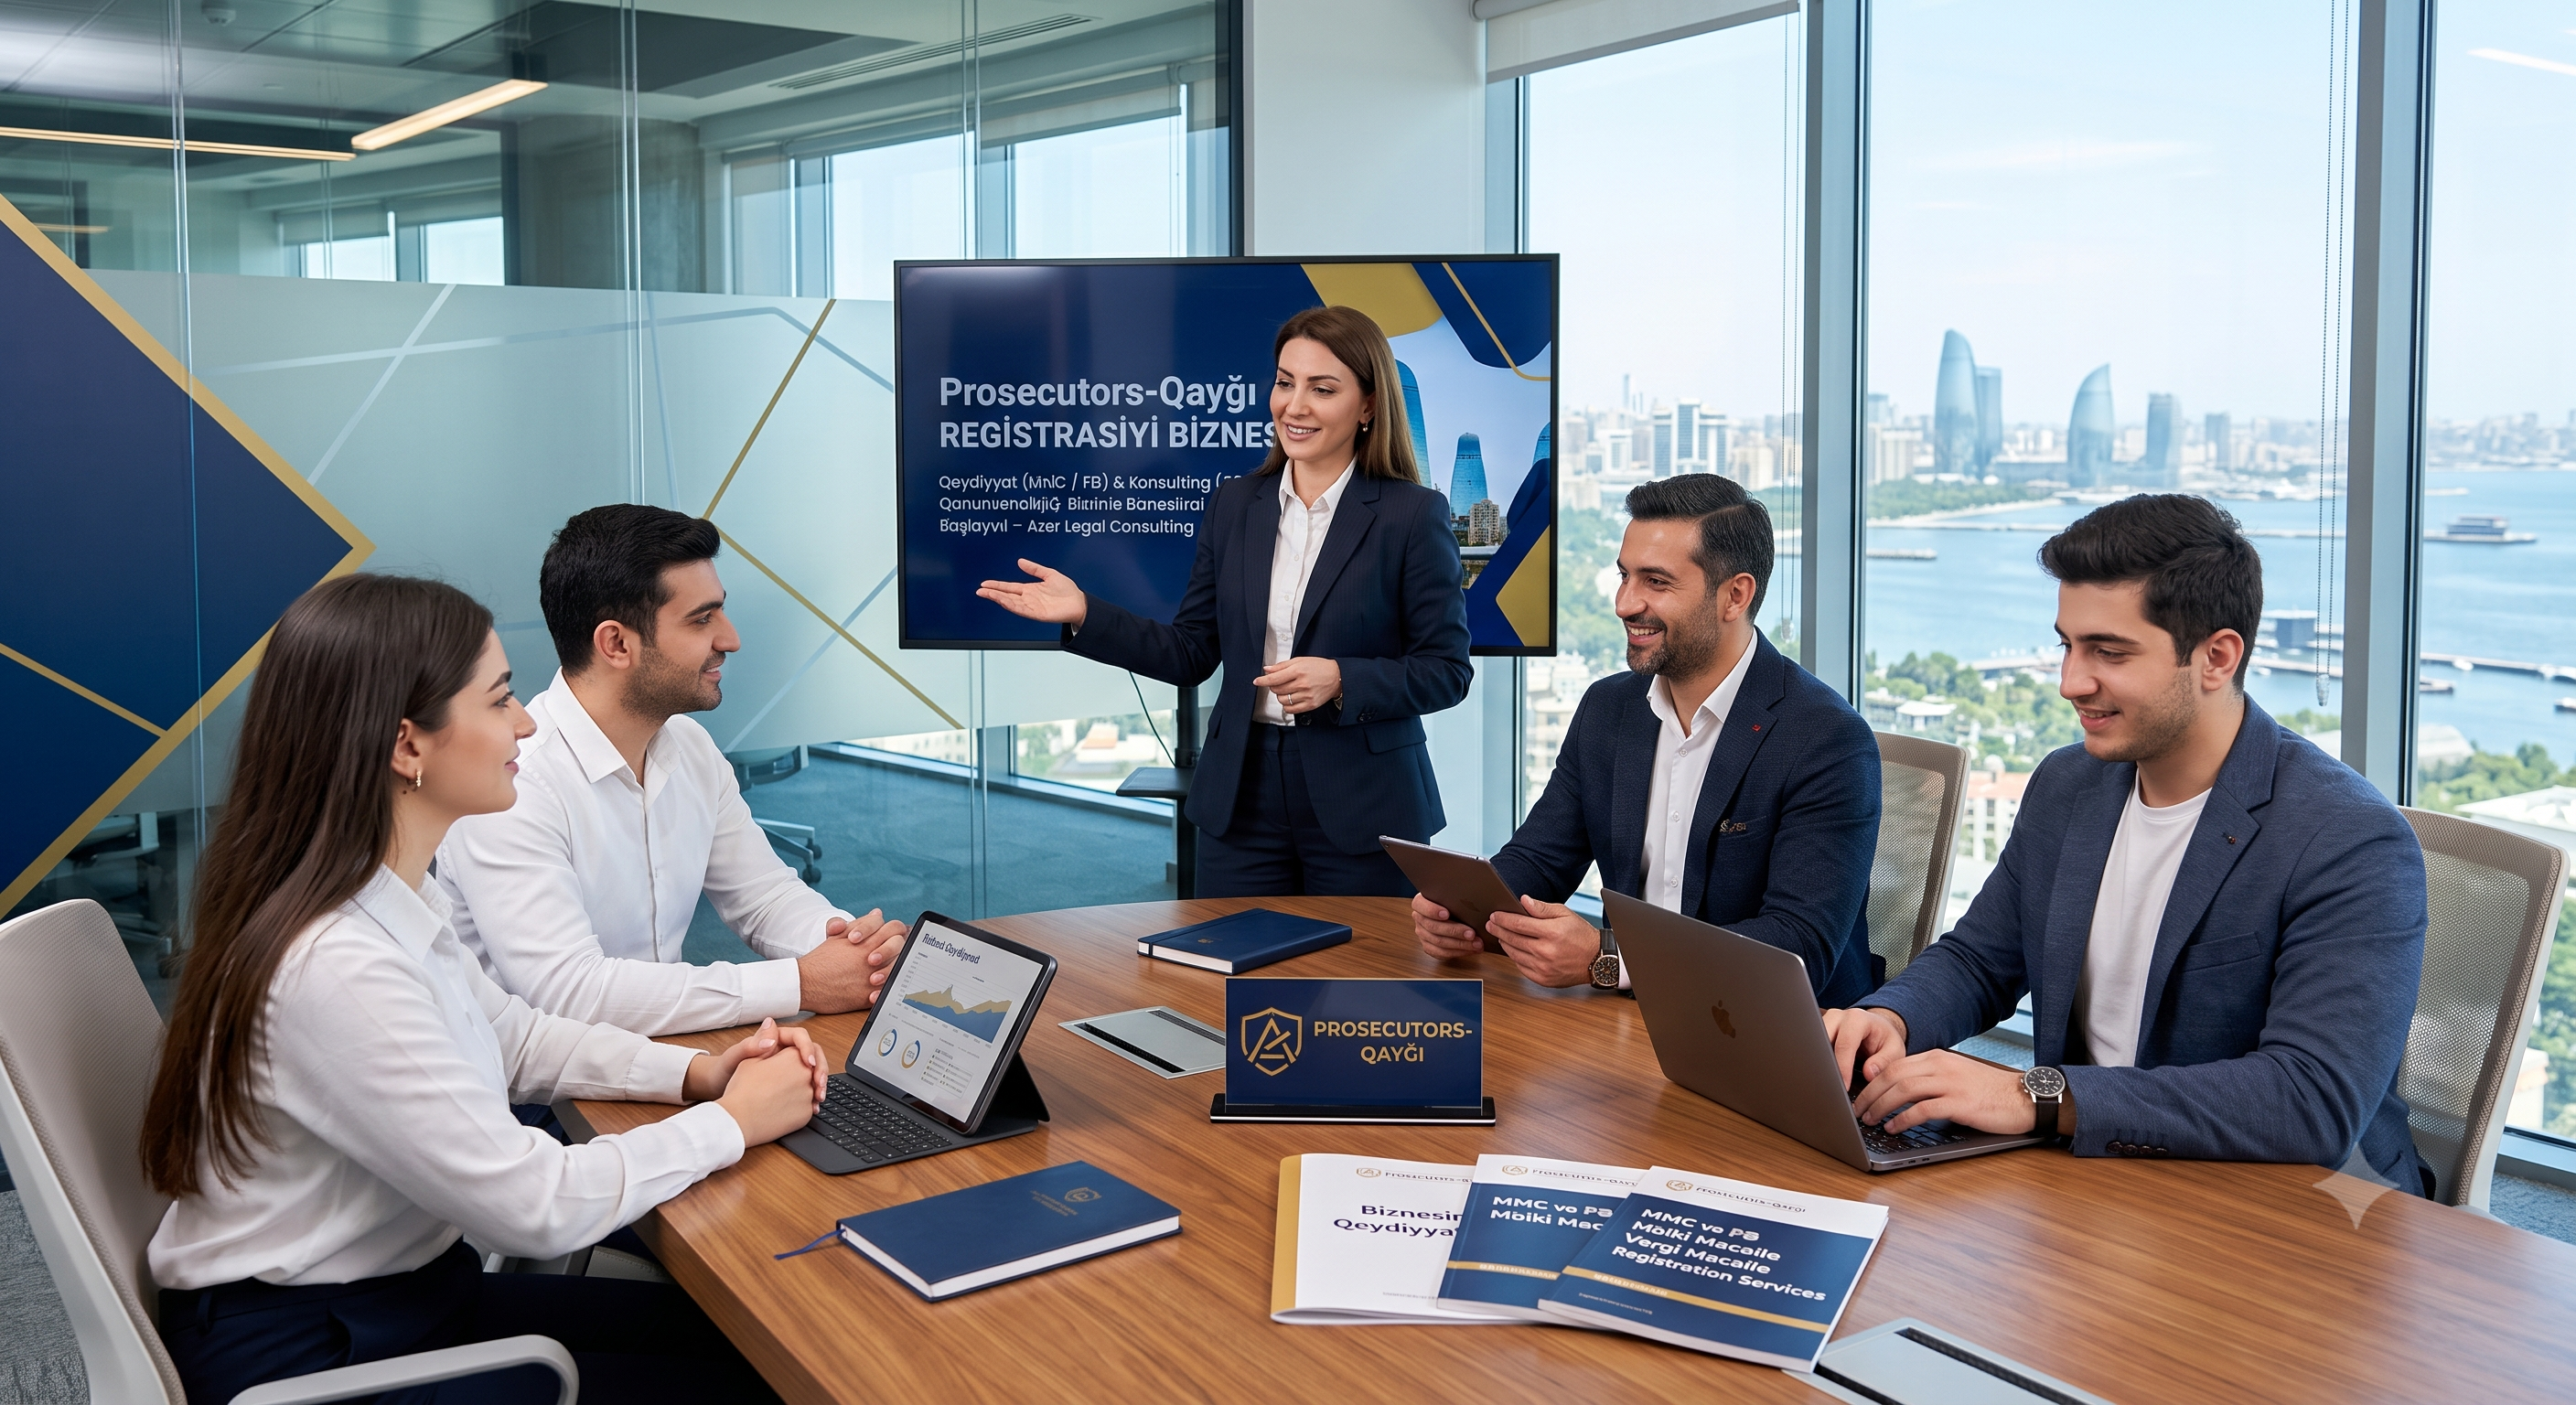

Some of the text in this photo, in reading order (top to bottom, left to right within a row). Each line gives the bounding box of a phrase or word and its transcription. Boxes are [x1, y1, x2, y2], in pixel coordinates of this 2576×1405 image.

[939, 374, 1256, 414] Prosecutors-Qayğı
[939, 415, 1159, 448] REGİSTRASİYİ
[939, 475, 1017, 492] Qeydiyyat
[1071, 472, 1078, 491] /
[1083, 472, 1109, 492] FB)
[1112, 476, 1125, 489] &
[1129, 475, 1211, 493] Konsulting
[1027, 520, 1061, 532] Azer
[1065, 520, 1106, 537] Legal
[1110, 520, 1194, 537] Consulting
[1314, 1021, 1473, 1038] PROSECUTORS-
[1360, 1043, 1424, 1065] QAYĞI
[1493, 1196, 1549, 1210] MMC
[1334, 1218, 1459, 1238] Qeydiyya
[1641, 1208, 1697, 1228] MMC
[1626, 1232, 1682, 1255] Vergi
[1612, 1246, 1827, 1301] Registration Services
